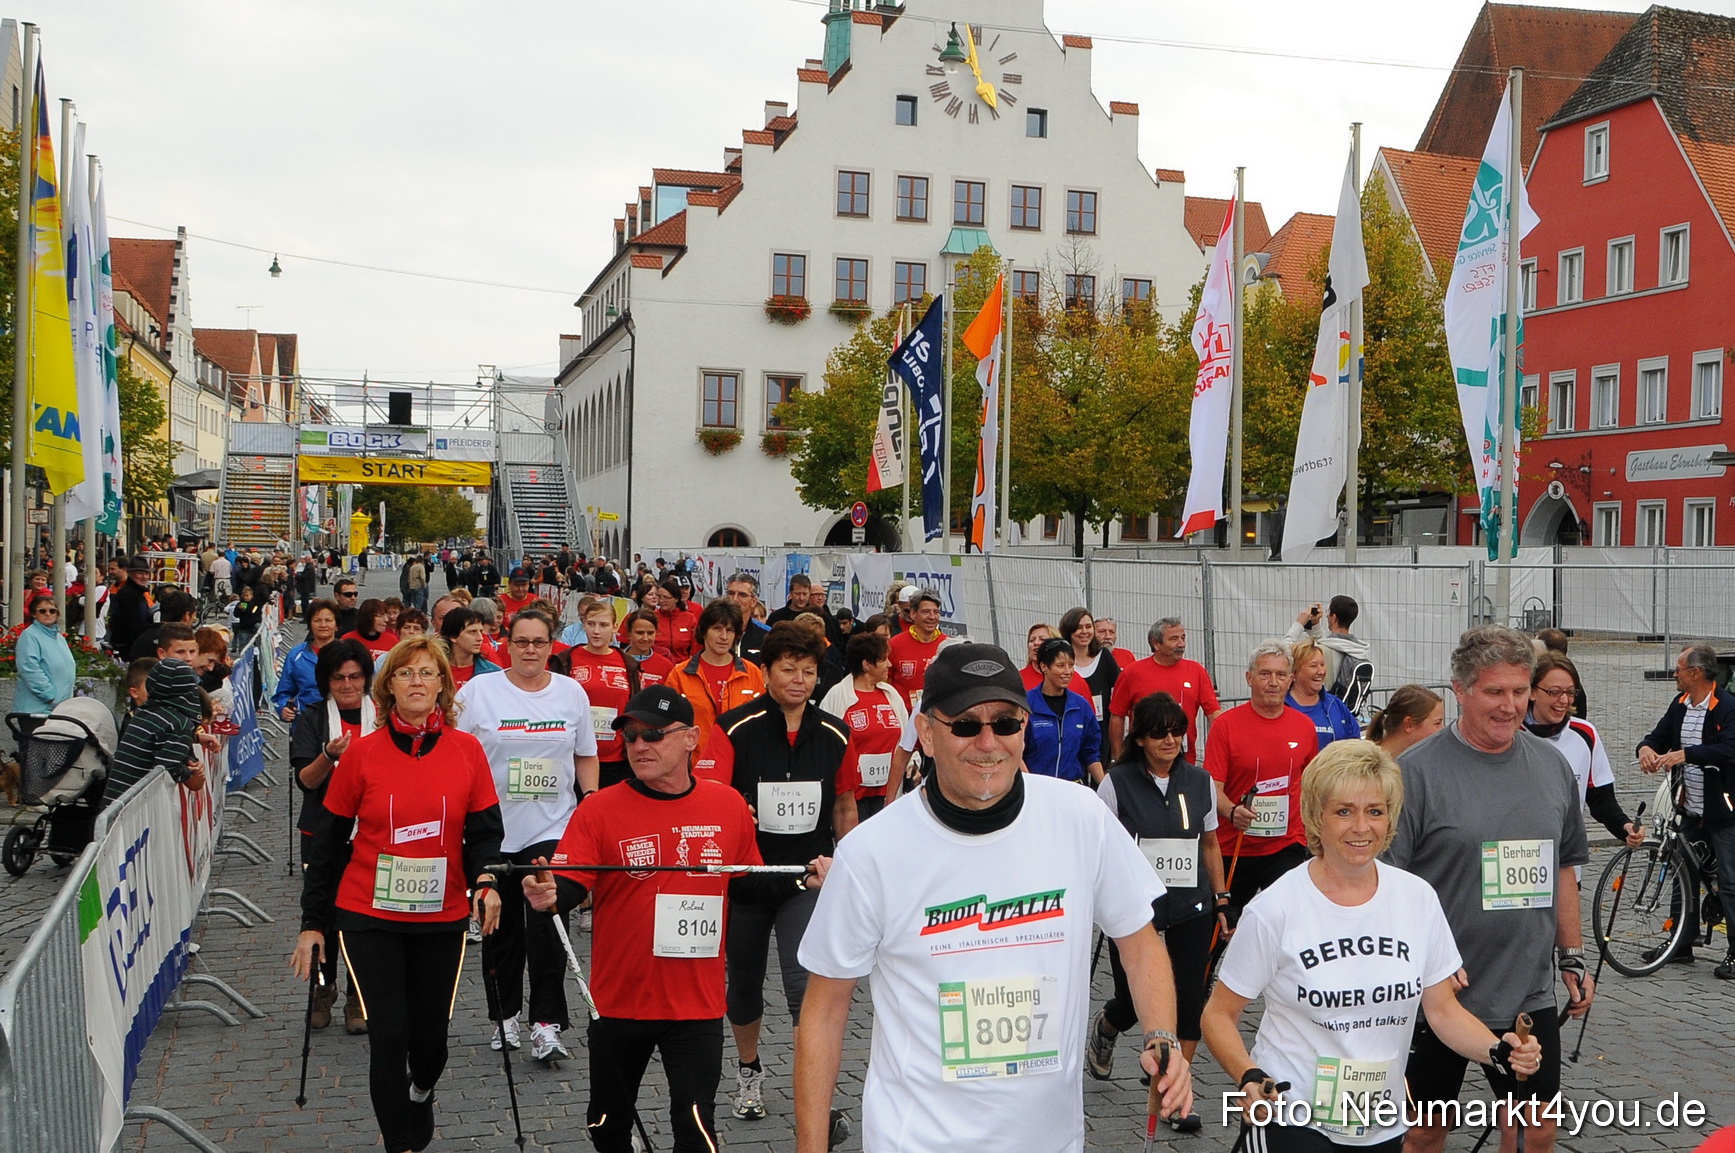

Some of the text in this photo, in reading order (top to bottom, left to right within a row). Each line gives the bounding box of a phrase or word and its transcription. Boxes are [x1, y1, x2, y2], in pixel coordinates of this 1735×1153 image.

[328, 431, 403, 449] BOCK
[449, 438, 492, 448] PFLEIDERER
[361, 462, 428, 479] START
[1630, 453, 1713, 477] Gasthaus Ehrnsberg
[524, 760, 543, 770] Doris
[524, 774, 558, 788] 8062
[1265, 781, 1280, 789] DEHN
[771, 786, 802, 797] Maria
[776, 801, 816, 817] 8115
[1254, 799, 1278, 808] Johann
[1254, 810, 1286, 823] 8075
[407, 827, 428, 838] DEHN
[626, 841, 655, 852] IMMER
[1502, 845, 1541, 859] Gerhard
[625, 848, 656, 860] WIEDER
[628, 855, 655, 867] NEU
[395, 860, 437, 873] Marianne
[1155, 856, 1193, 871] 8103
[1506, 865, 1548, 886] 8069
[394, 877, 440, 894] 8082
[678, 899, 705, 912] Roland
[986, 892, 1062, 926] ITALIA
[677, 918, 718, 937] 8104
[930, 930, 1065, 952] FEINE ITALIENISCHE SPEZIALITÄTEN
[1298, 935, 1411, 971] BERGER
[970, 986, 1041, 1008] Wolfgang
[1296, 975, 1422, 1009] POWER GIRLS
[976, 1013, 1049, 1046] 8097
[1352, 1016, 1373, 1030] and
[1018, 1056, 1060, 1070] PFLEIDERER
[1342, 1064, 1387, 1082] Carmen
